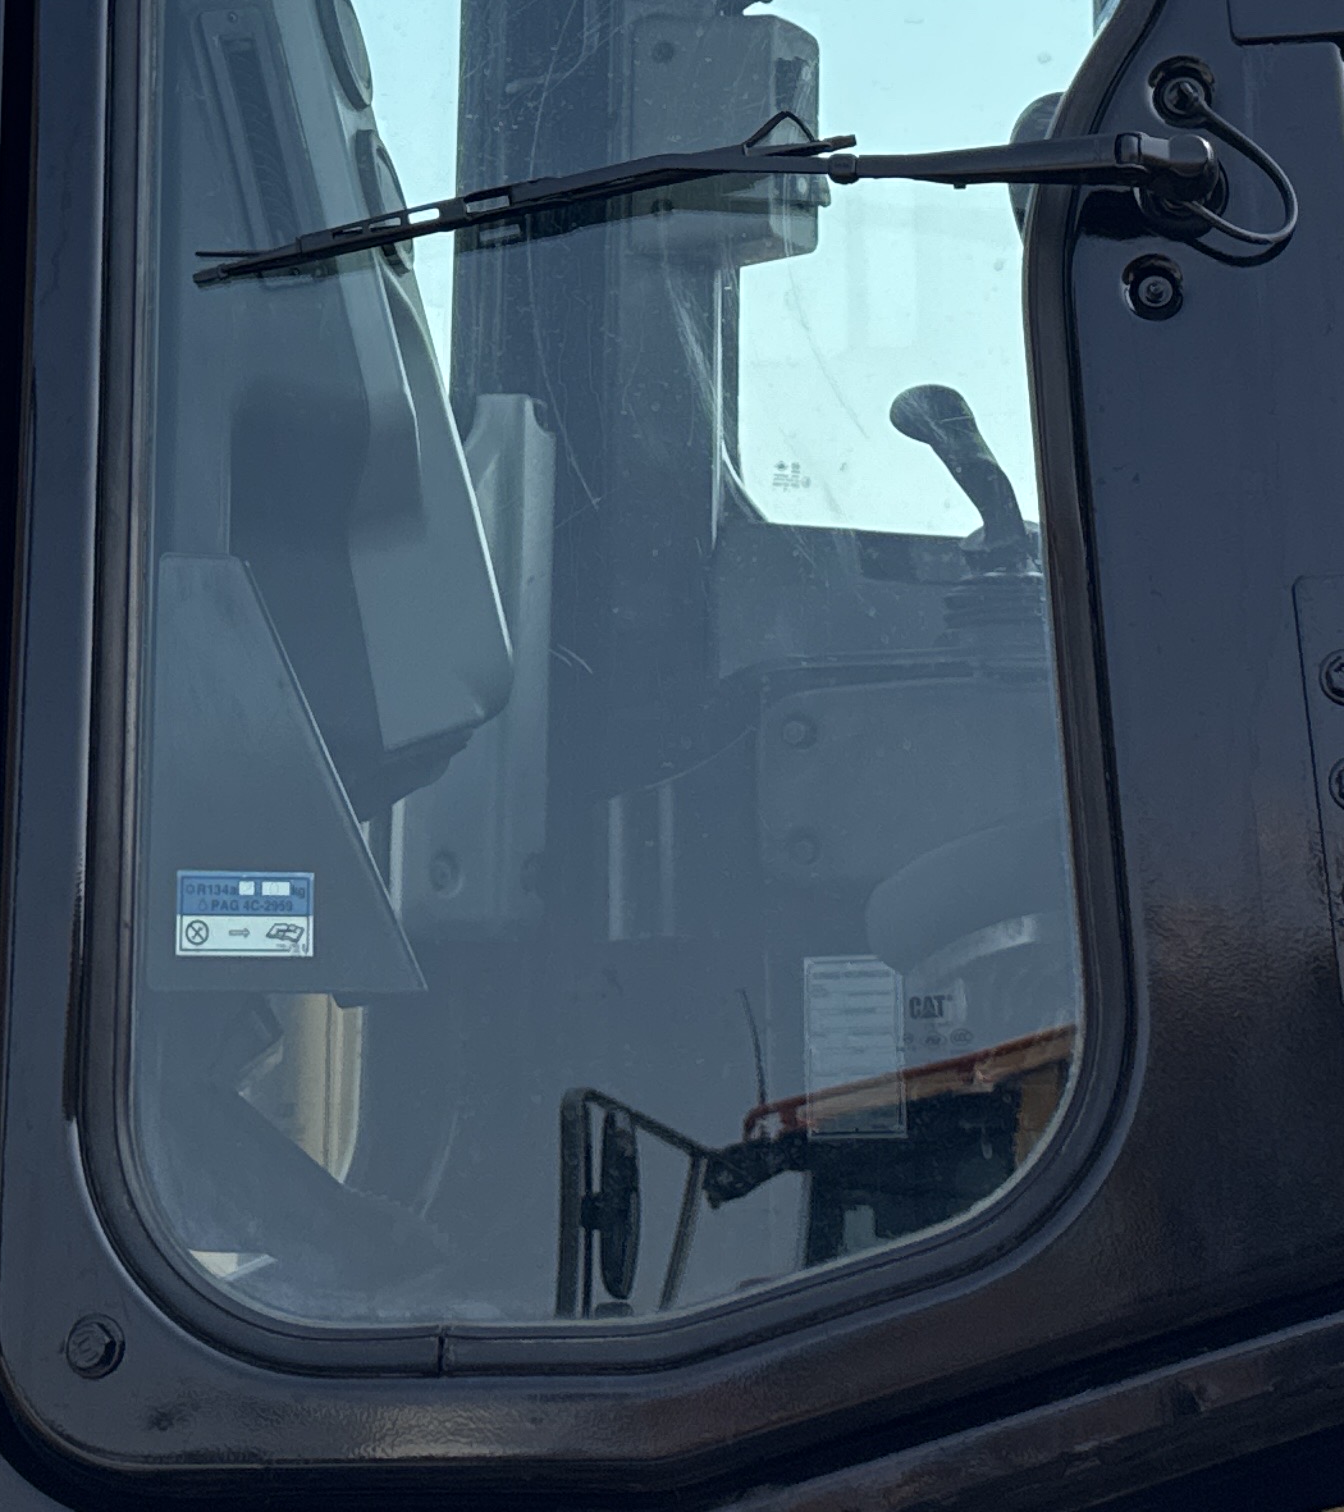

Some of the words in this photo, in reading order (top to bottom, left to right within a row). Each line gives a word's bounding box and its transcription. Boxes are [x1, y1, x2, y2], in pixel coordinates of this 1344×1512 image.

[197, 883, 239, 896] R134a
[211, 899, 239, 912] PAG
[909, 994, 946, 1019] CAT
